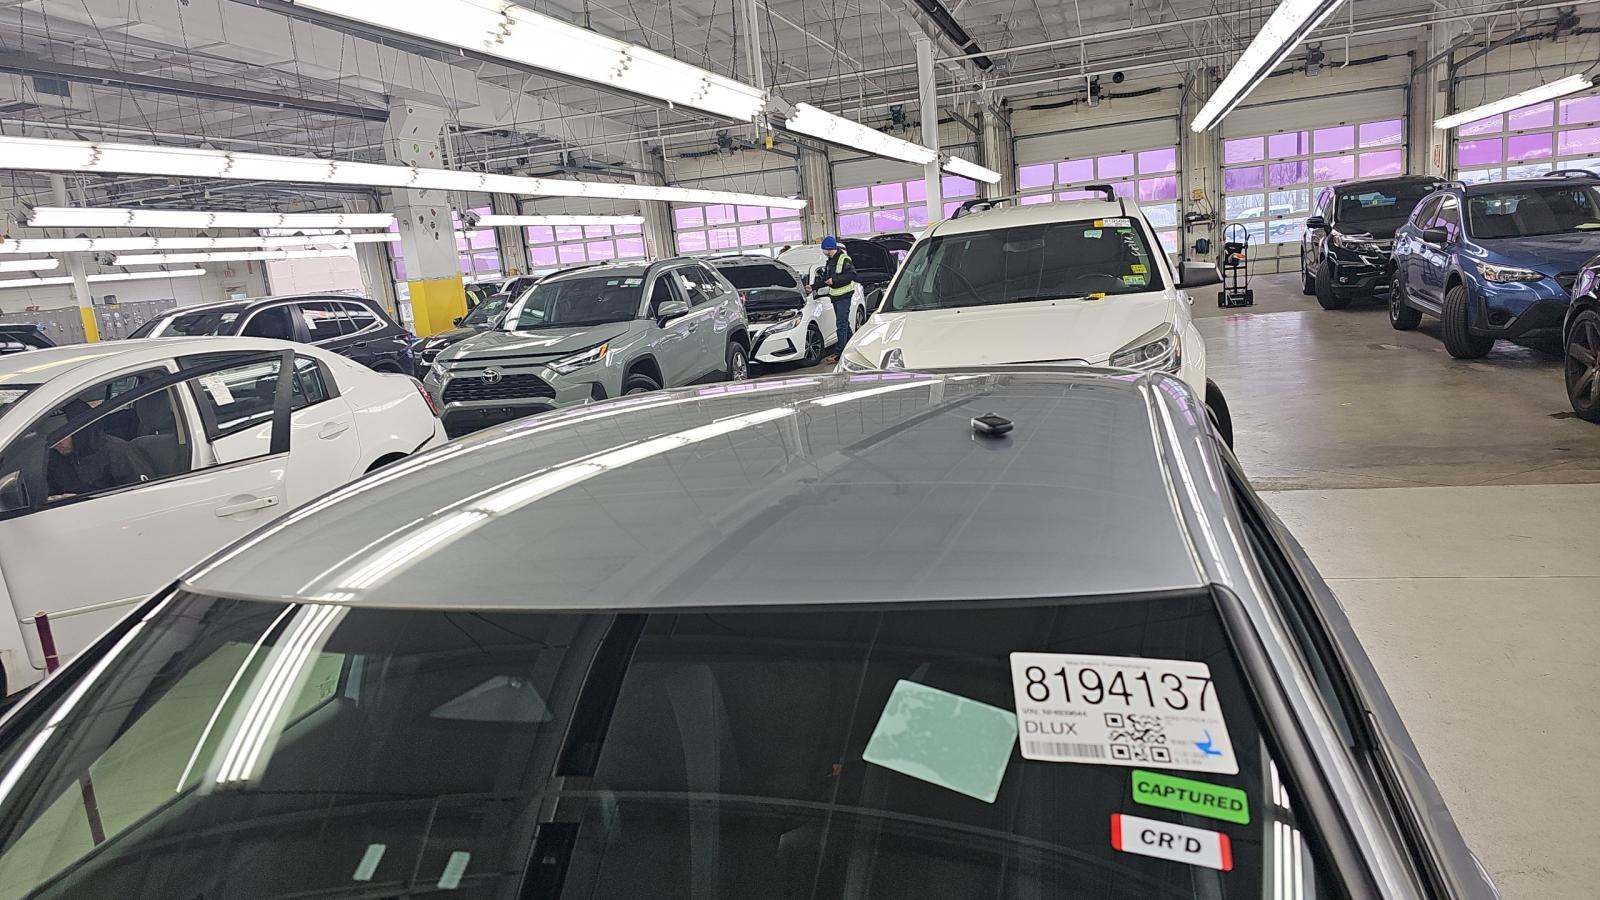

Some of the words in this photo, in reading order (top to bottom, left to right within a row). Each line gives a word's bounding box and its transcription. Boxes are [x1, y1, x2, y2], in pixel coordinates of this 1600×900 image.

[1025, 665, 1212, 711] 8194137
[1025, 720, 1078, 736] DLUX
[1137, 781, 1243, 812] CAPTURED
[1141, 829, 1202, 853] CR'D
